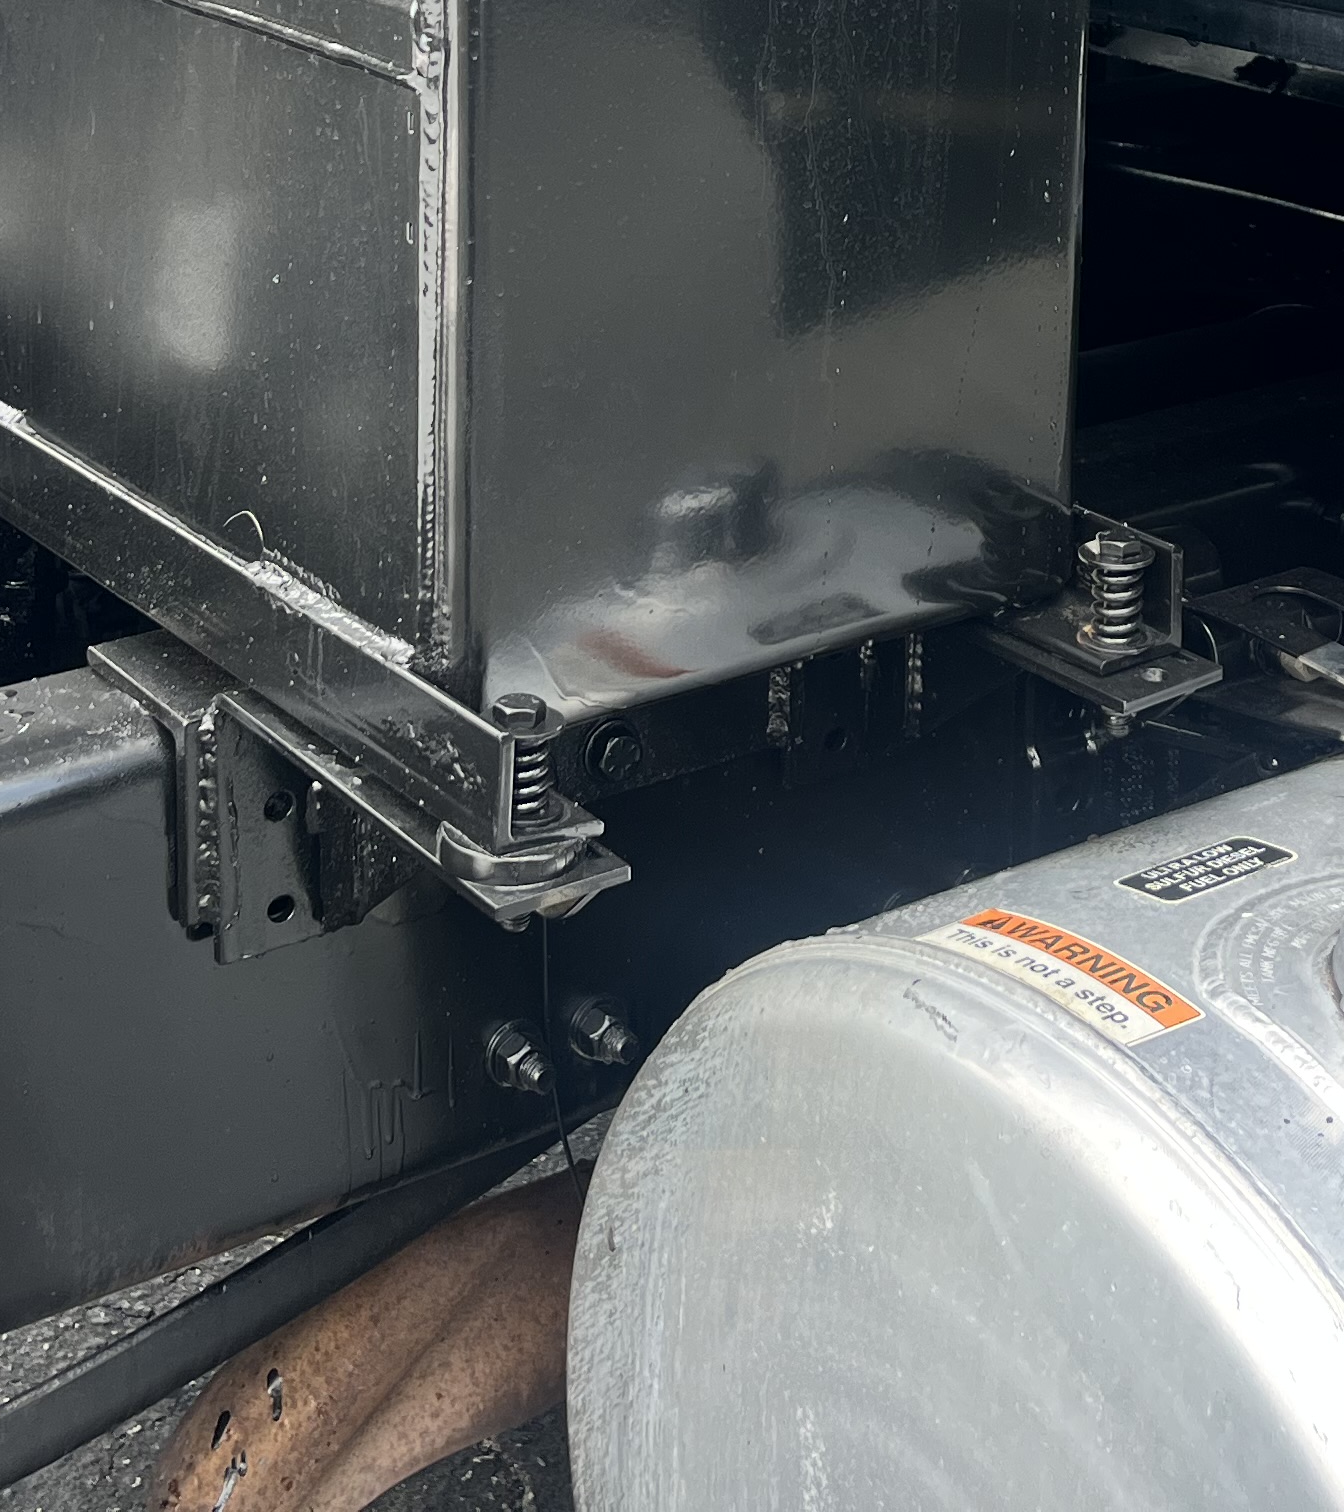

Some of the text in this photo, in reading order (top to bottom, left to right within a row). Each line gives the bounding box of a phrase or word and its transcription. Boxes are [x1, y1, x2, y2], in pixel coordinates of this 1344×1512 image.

[1141, 843, 1233, 880] ULTRA LOW
[1145, 845, 1267, 892] SULFUR DIESEL
[1178, 856, 1265, 892] FUEL ONLY
[947, 928, 1131, 1029] This is not a step.
[1007, 922, 1174, 1014] WARNING
